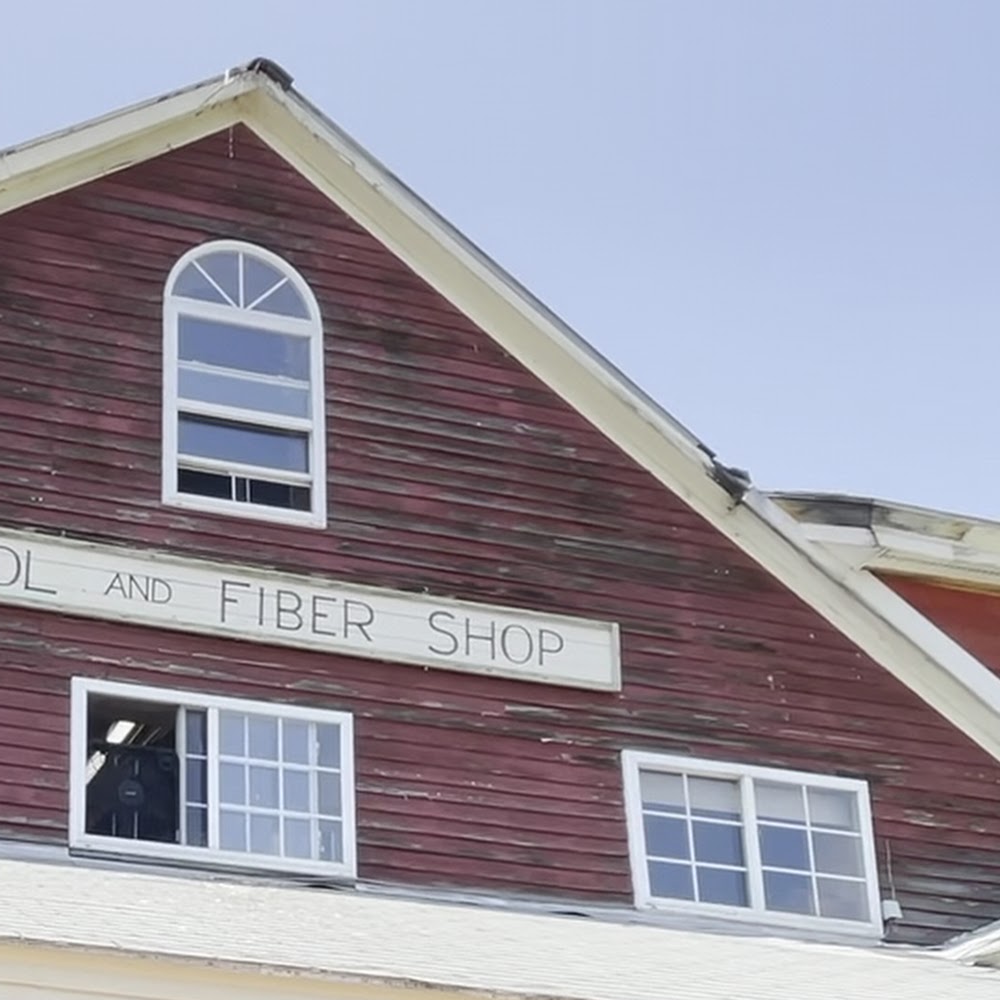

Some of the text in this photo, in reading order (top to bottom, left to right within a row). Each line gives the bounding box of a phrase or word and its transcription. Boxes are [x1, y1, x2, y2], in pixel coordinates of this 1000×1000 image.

[103, 571, 173, 605] AND
[219, 578, 375, 642] FIBER
[427, 609, 565, 667] SHOP
